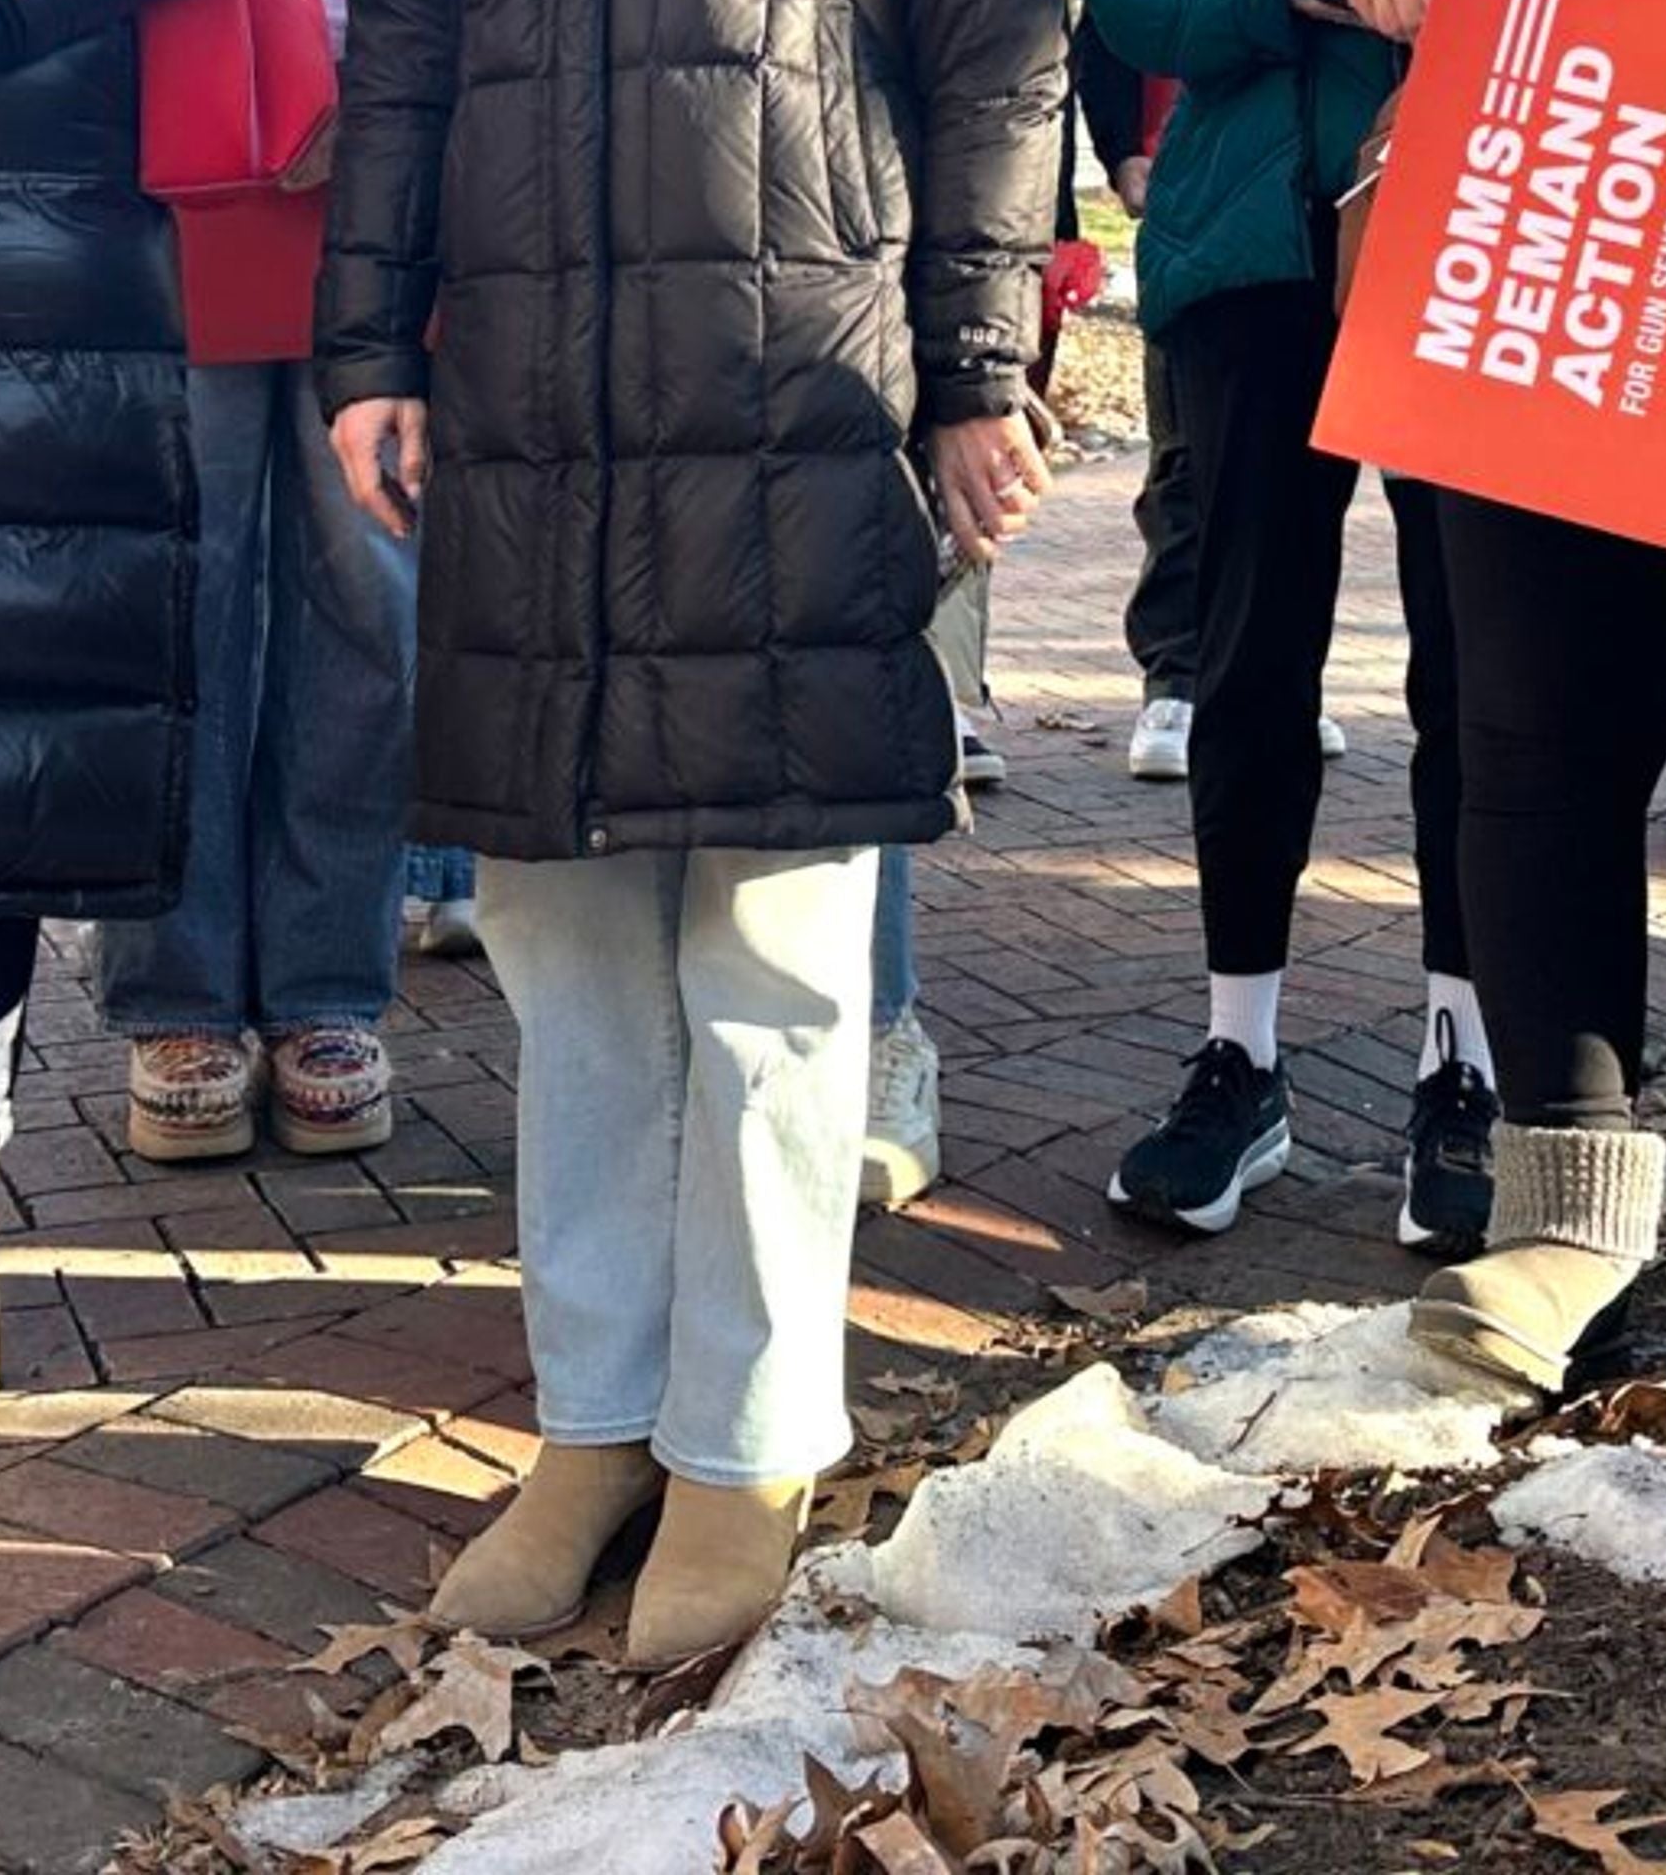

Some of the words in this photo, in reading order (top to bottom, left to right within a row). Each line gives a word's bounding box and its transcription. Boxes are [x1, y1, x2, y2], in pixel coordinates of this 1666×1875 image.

[1414, 123, 1525, 371] MOMS
[1480, 45, 1615, 388] DEMAND
[1619, 361, 1658, 417] FOR
